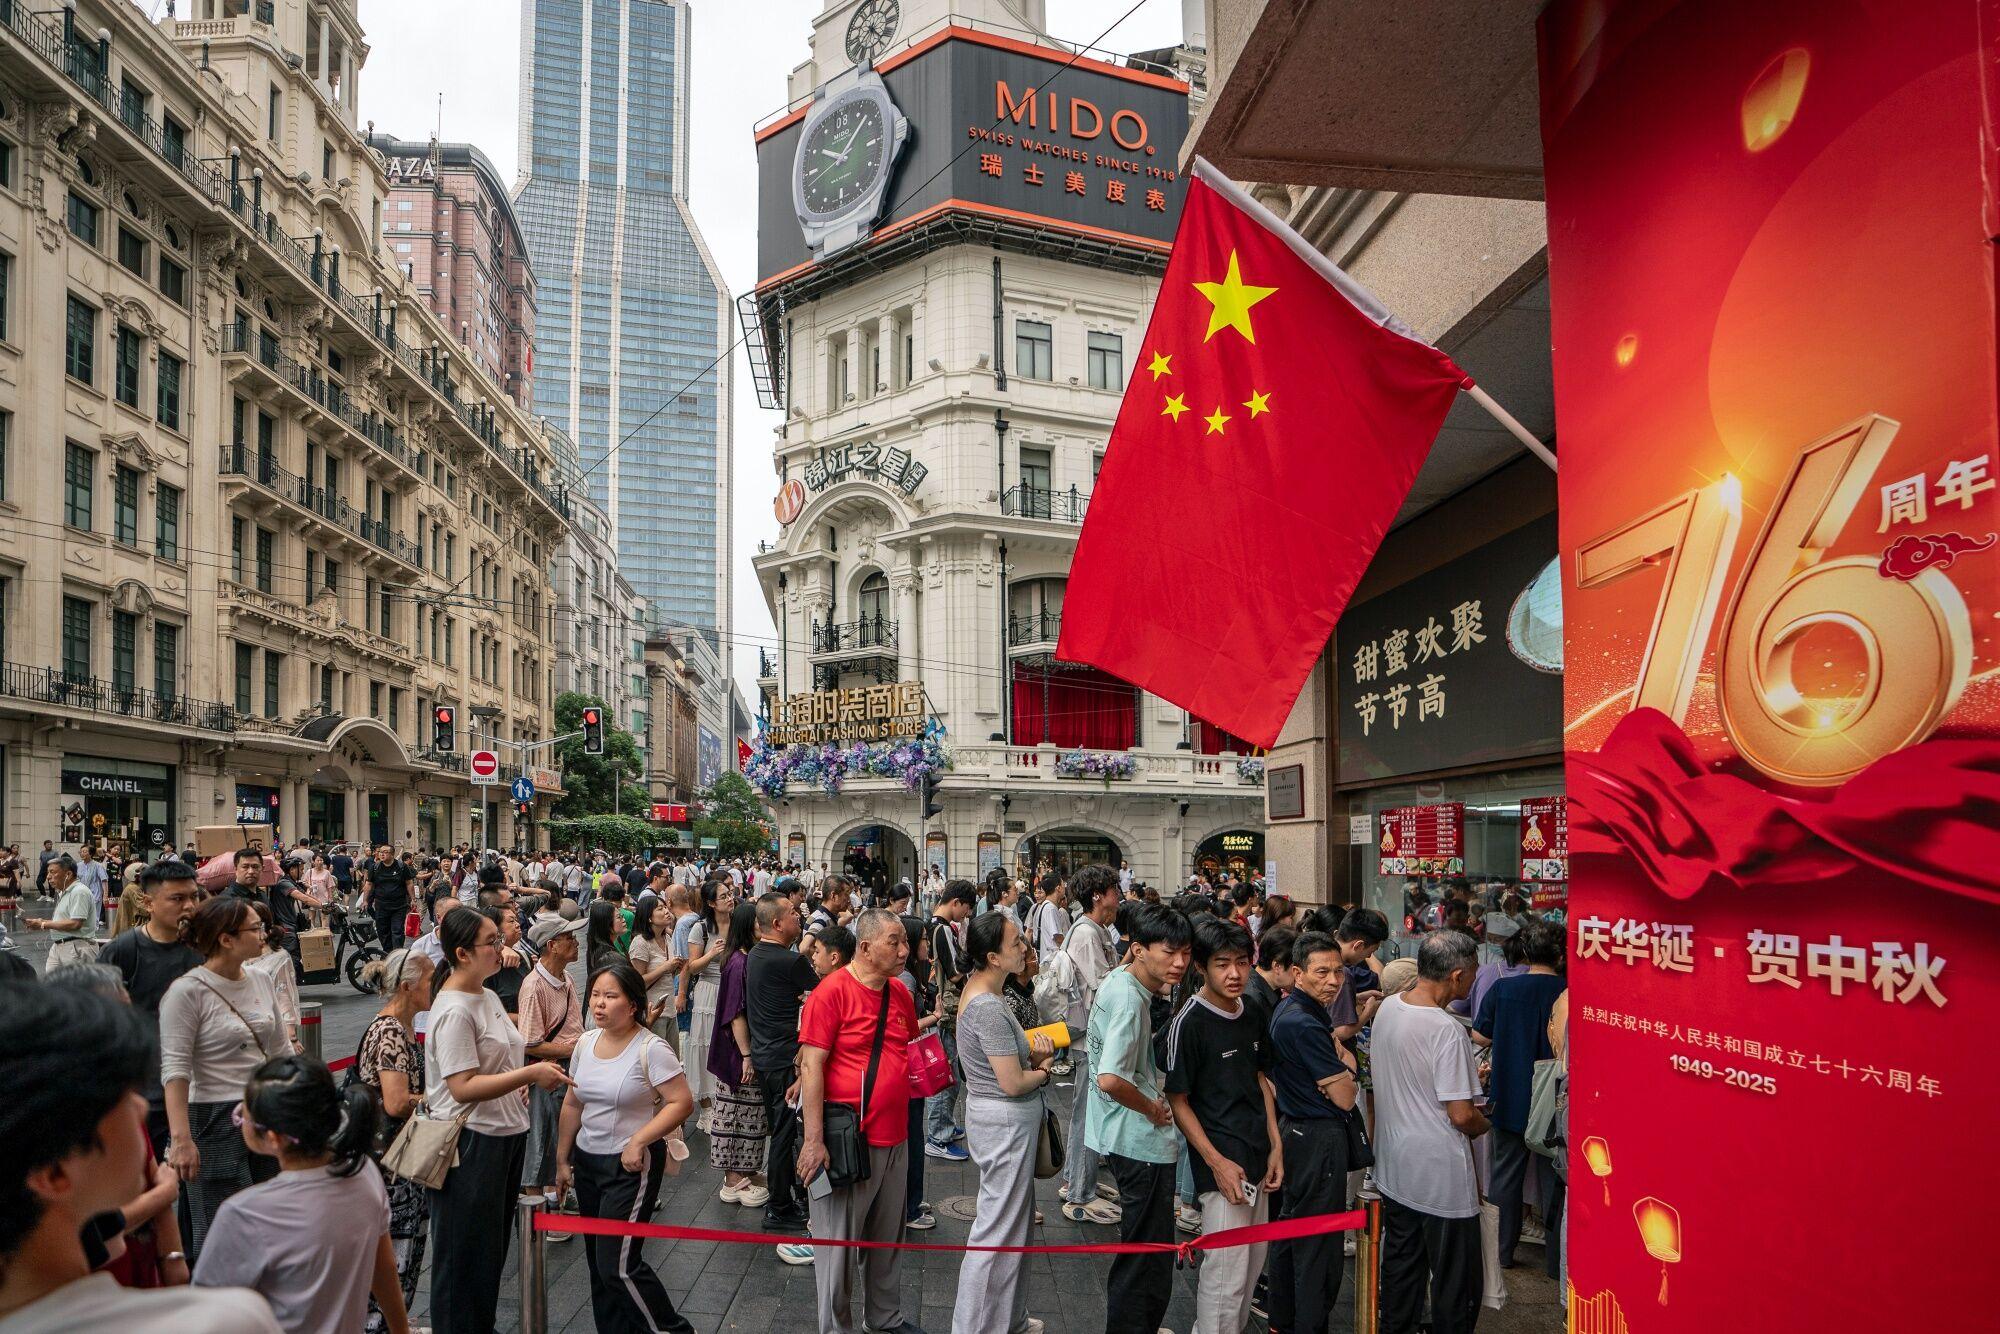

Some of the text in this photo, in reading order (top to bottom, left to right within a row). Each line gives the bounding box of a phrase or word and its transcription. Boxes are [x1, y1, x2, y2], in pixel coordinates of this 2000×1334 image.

[969, 127, 1176, 182] SWISS WATCHES SINCE 1918
[981, 153, 1166, 213] 瑞士美度表
[1575, 413, 1996, 788] 76 周年
[1352, 600, 1487, 684] 甜蜜欢聚
[765, 720, 922, 744] SHANGHAI FASHION STORE
[770, 682, 925, 728] 上海时装商店
[1354, 673, 1446, 737] 节节高
[80, 776, 142, 793] CHANEL
[1582, 1005, 1943, 1098] 热烈庆祝中华人民共和国成立七十六周年
[1669, 1053, 1778, 1096] 1949-2025
